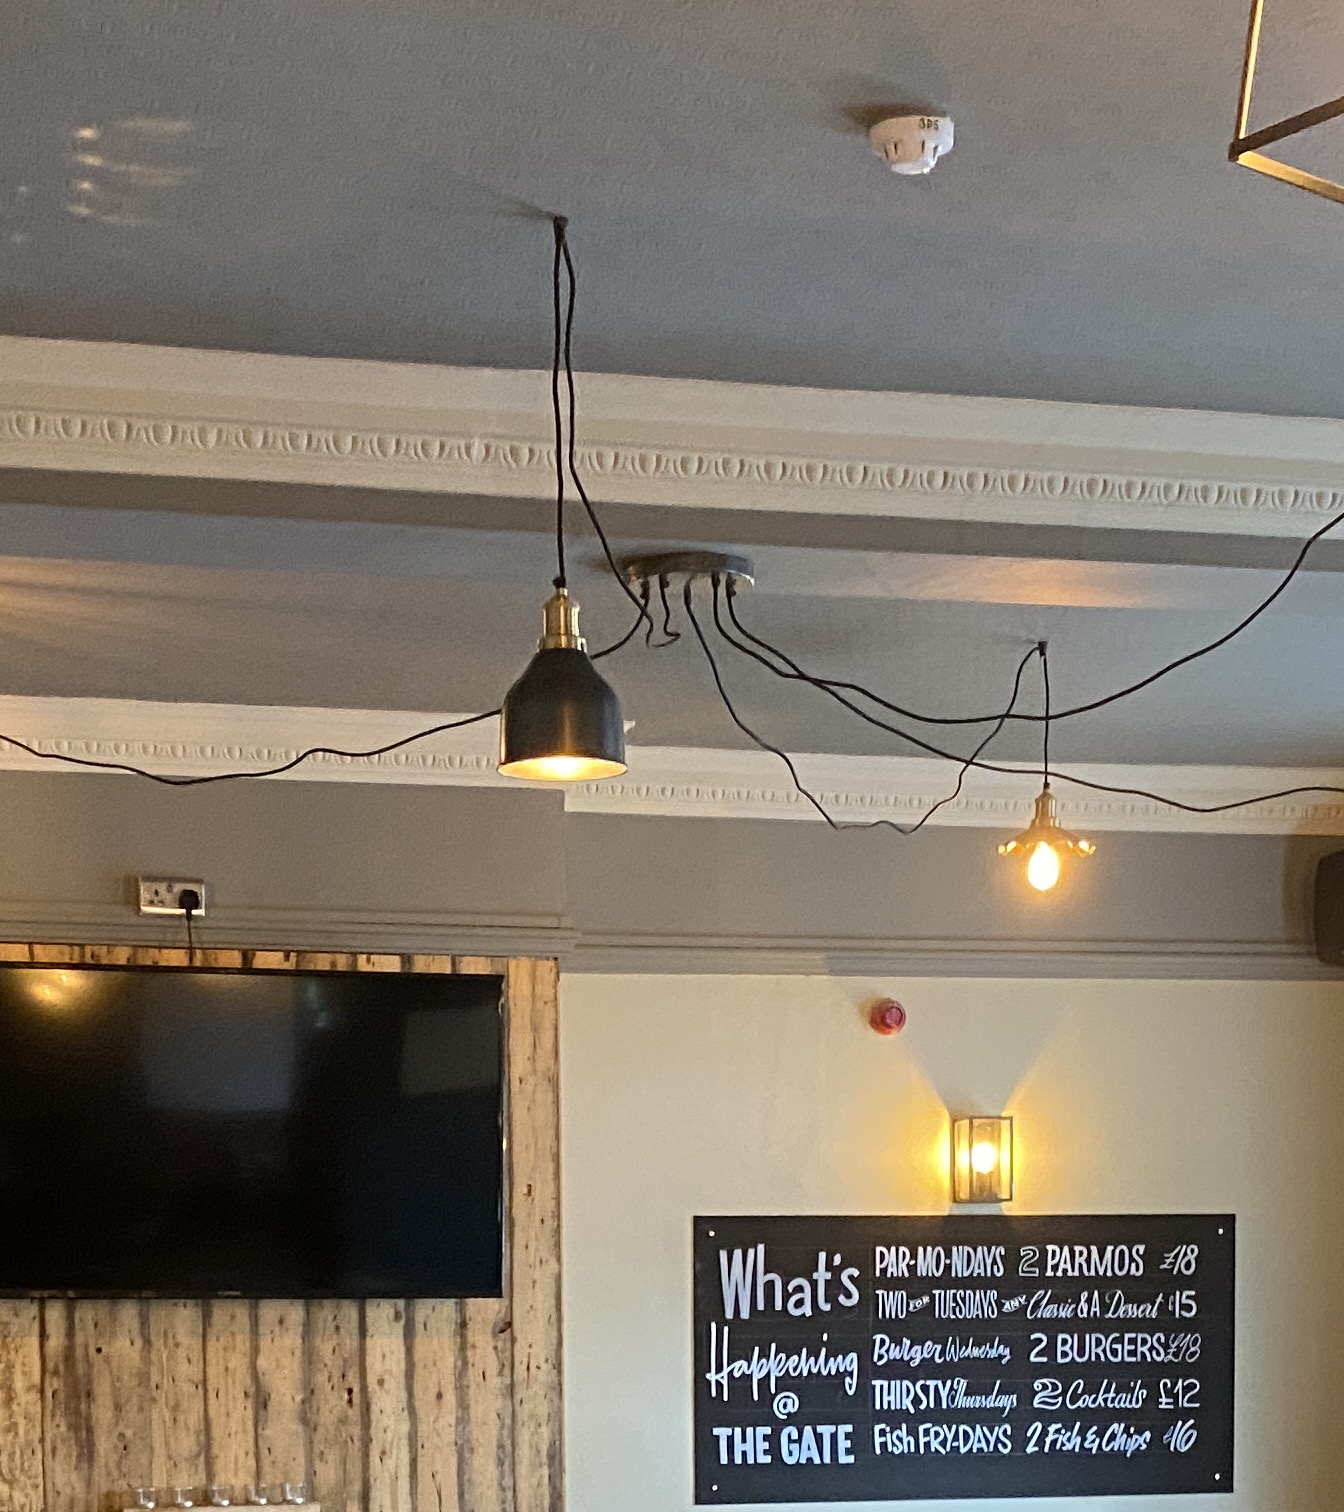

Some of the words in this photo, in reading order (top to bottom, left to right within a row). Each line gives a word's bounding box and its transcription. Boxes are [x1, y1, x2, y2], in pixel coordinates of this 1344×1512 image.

[1018, 1246, 1040, 1277] 2
[1045, 1244, 1146, 1277] PARMOS
[1159, 1244, 1199, 1276] £18
[719, 1243, 860, 1319] What's
[875, 1289, 906, 1319] TWO
[908, 1295, 930, 1312] FOR
[932, 1289, 998, 1319] TUESDAYS
[1001, 1295, 1028, 1313] ANY
[1026, 1289, 1076, 1320] Classic
[1104, 1289, 1164, 1320] Dessert
[705, 1321, 858, 1402] Happening
[872, 1333, 944, 1367] Burger
[945, 1336, 1012, 1365] Wednesday
[1029, 1333, 1048, 1363] 2
[1056, 1333, 1165, 1363] BURGERS
[1164, 1333, 1202, 1363] £18
[773, 1391, 799, 1419] @
[871, 1379, 952, 1414] THIRSTY
[948, 1377, 1017, 1418] Thursdays
[1033, 1378, 1063, 1410] 2
[1066, 1379, 1147, 1409] Cocktails
[1158, 1378, 1201, 1409] £12
[712, 1426, 772, 1465] THE
[780, 1424, 855, 1465] GATE
[873, 1423, 915, 1455] Fish
[918, 1423, 1013, 1455] FRY-DAYS
[1026, 1421, 1043, 1455] 2
[1044, 1421, 1082, 1454] Fish
[1083, 1425, 1100, 1454] &
[1101, 1422, 1151, 1458] Chips
